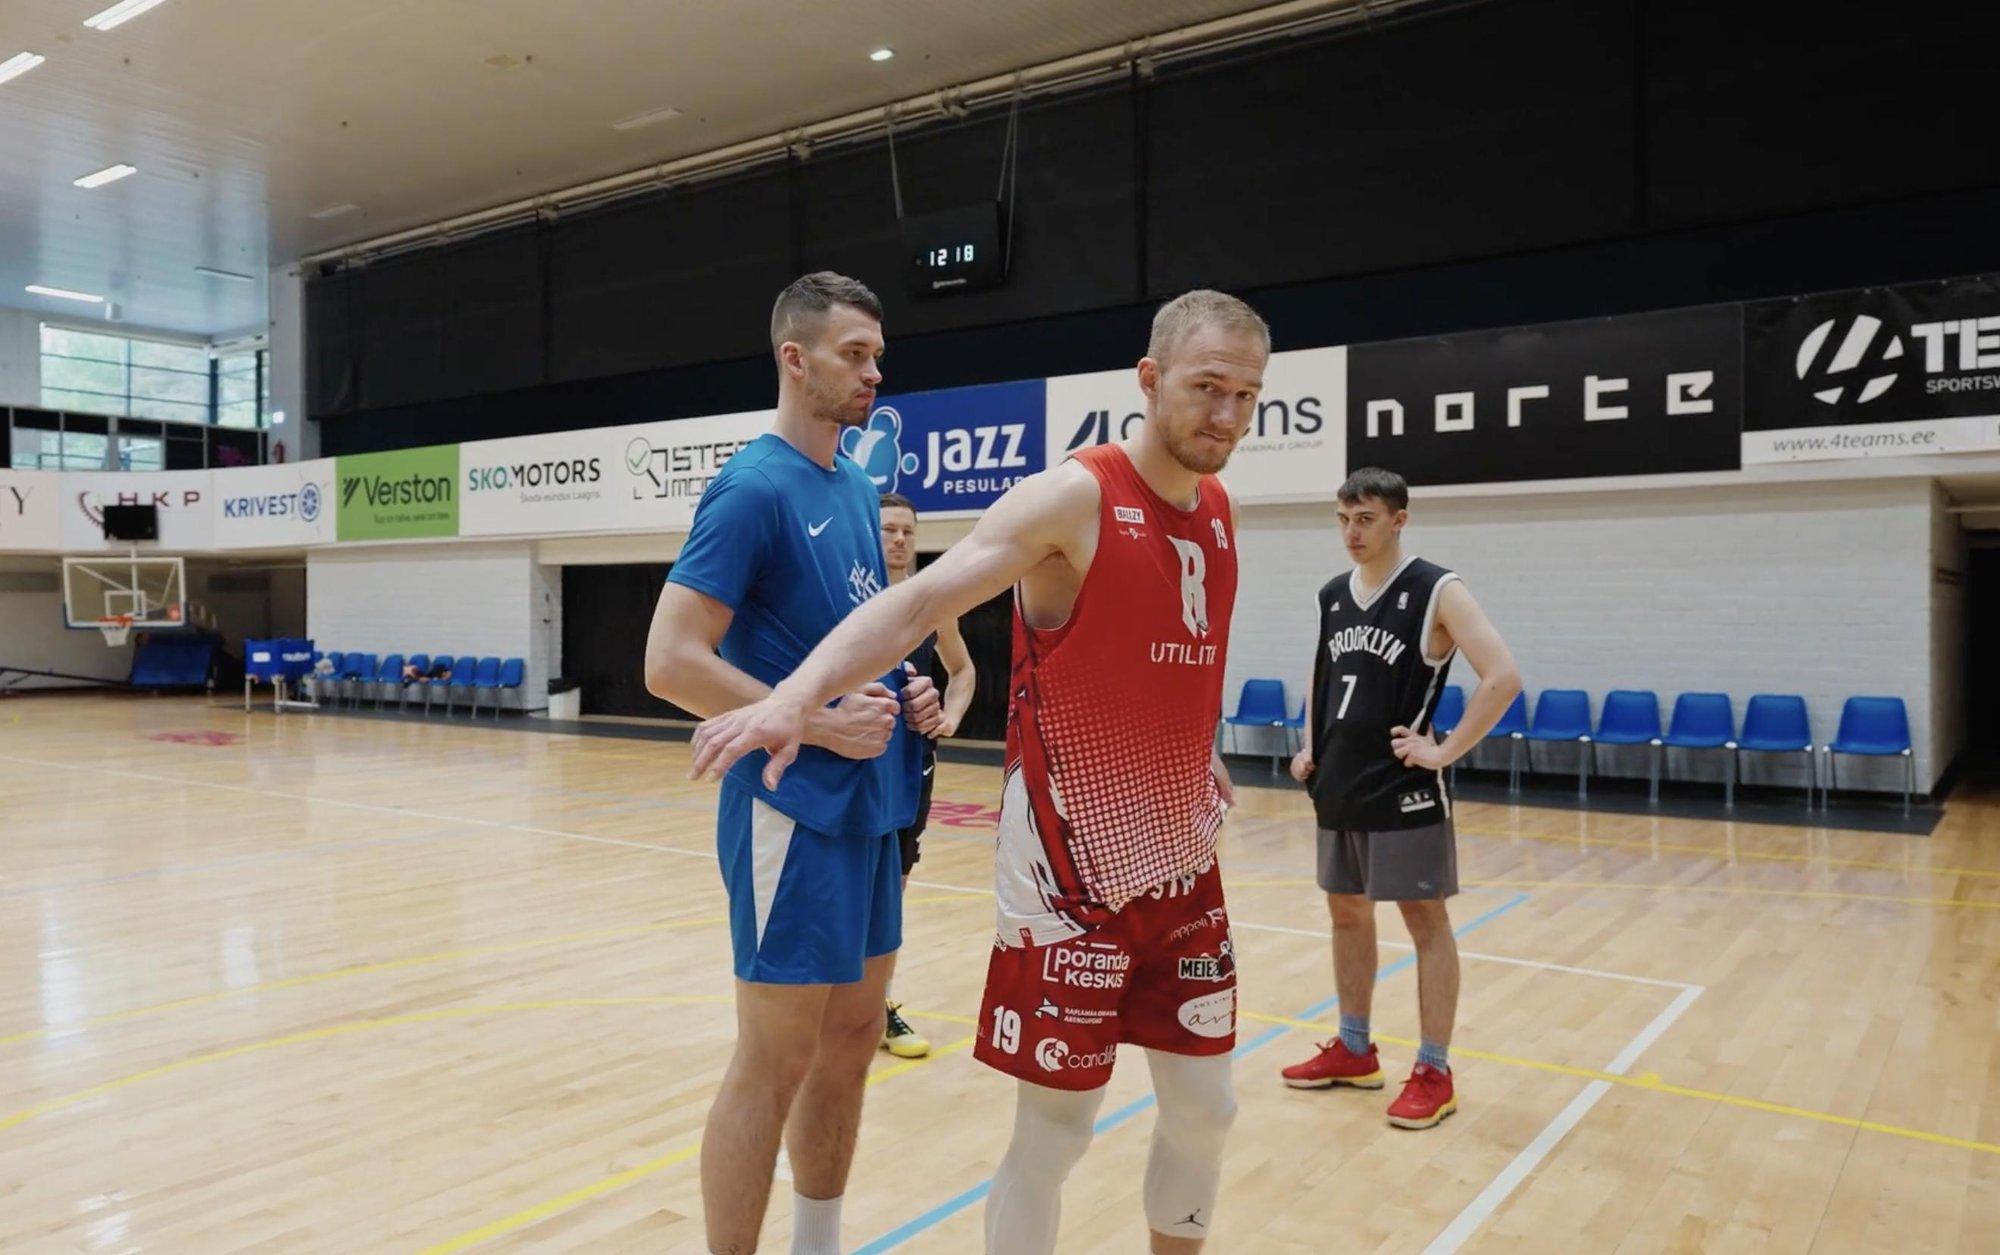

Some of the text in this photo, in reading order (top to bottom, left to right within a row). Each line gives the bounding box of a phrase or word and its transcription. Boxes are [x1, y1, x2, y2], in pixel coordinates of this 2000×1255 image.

[923, 424, 1026, 490] jazz
[1773, 431, 1936, 452] www.4teams.ee
[224, 493, 298, 518] KRIVEST
[363, 474, 450, 507] Verston
[1328, 625, 1407, 667] BROOKLYN
[1336, 675, 1357, 720] 7
[992, 1005, 1021, 1055] 19
